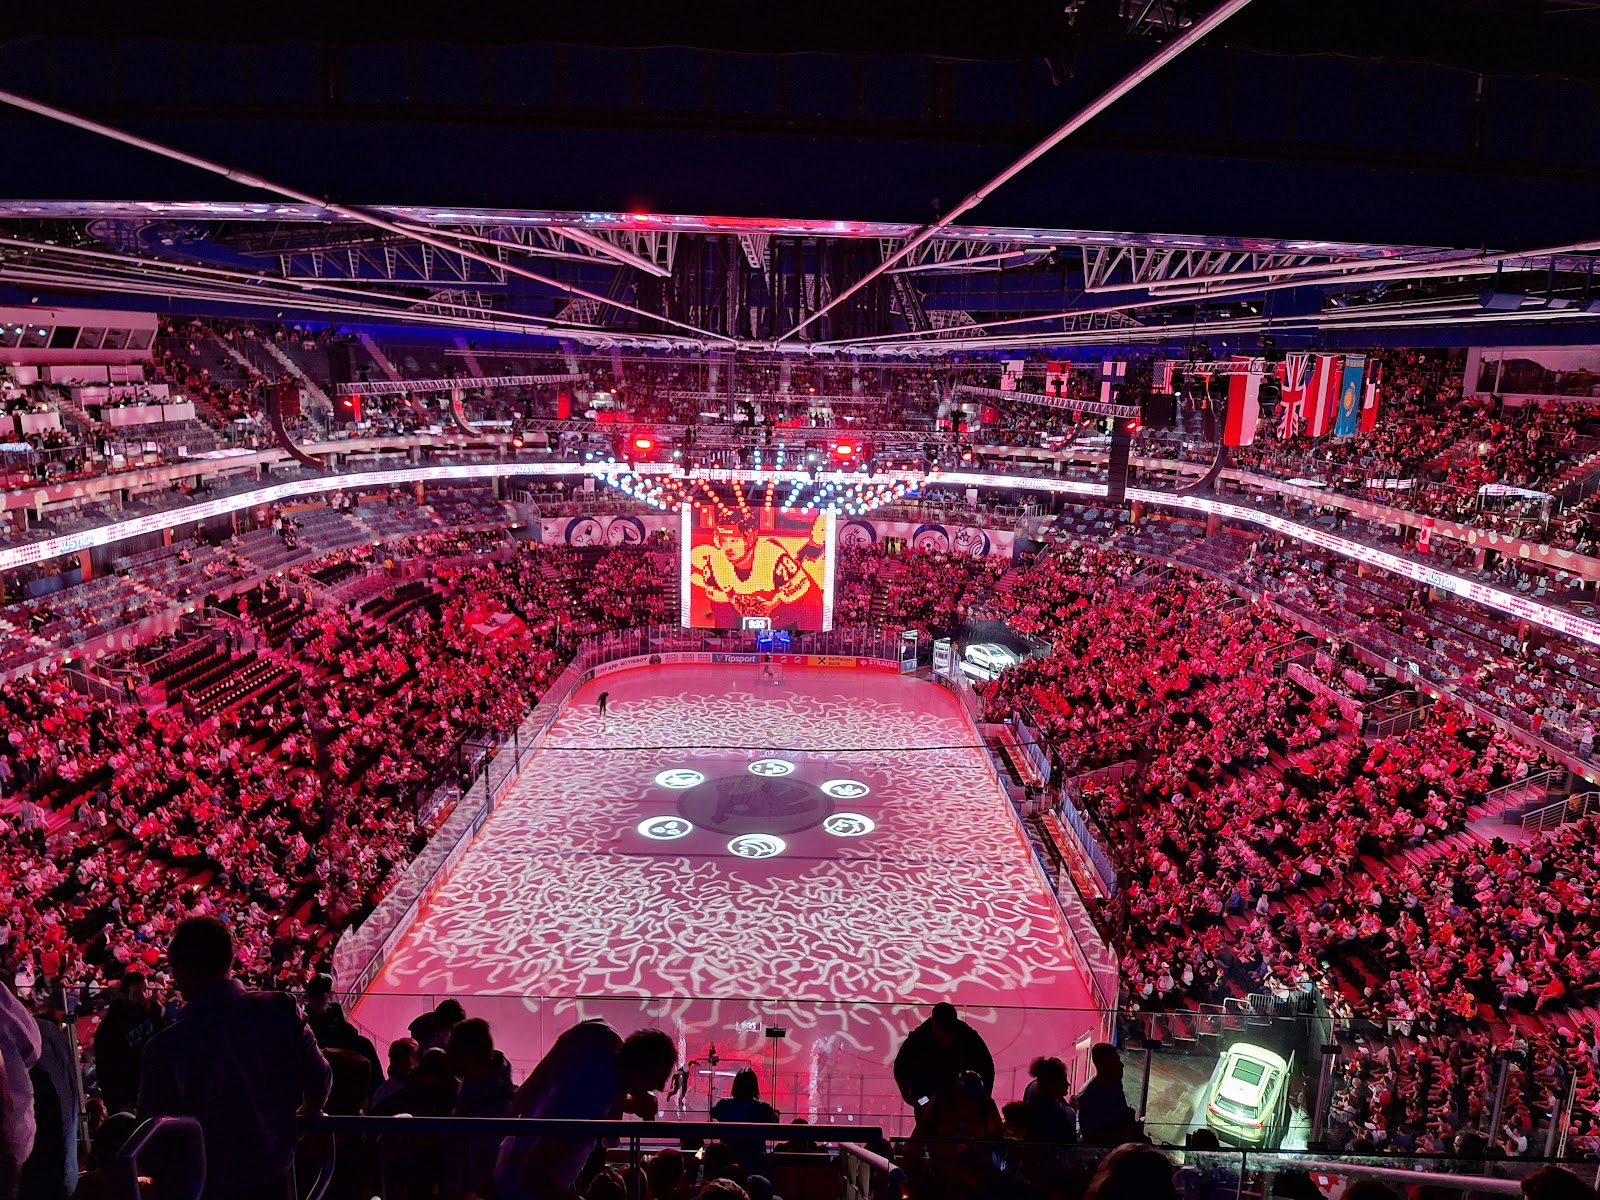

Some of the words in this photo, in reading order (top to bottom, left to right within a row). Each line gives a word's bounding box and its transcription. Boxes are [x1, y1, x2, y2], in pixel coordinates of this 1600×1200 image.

[59, 536, 94, 552] AUSTRIA
[1426, 571, 1457, 591] AUSTRIA
[628, 657, 647, 665] TISSOT
[724, 654, 756, 663] Tipsport
[868, 659, 897, 669] STRAUSS
